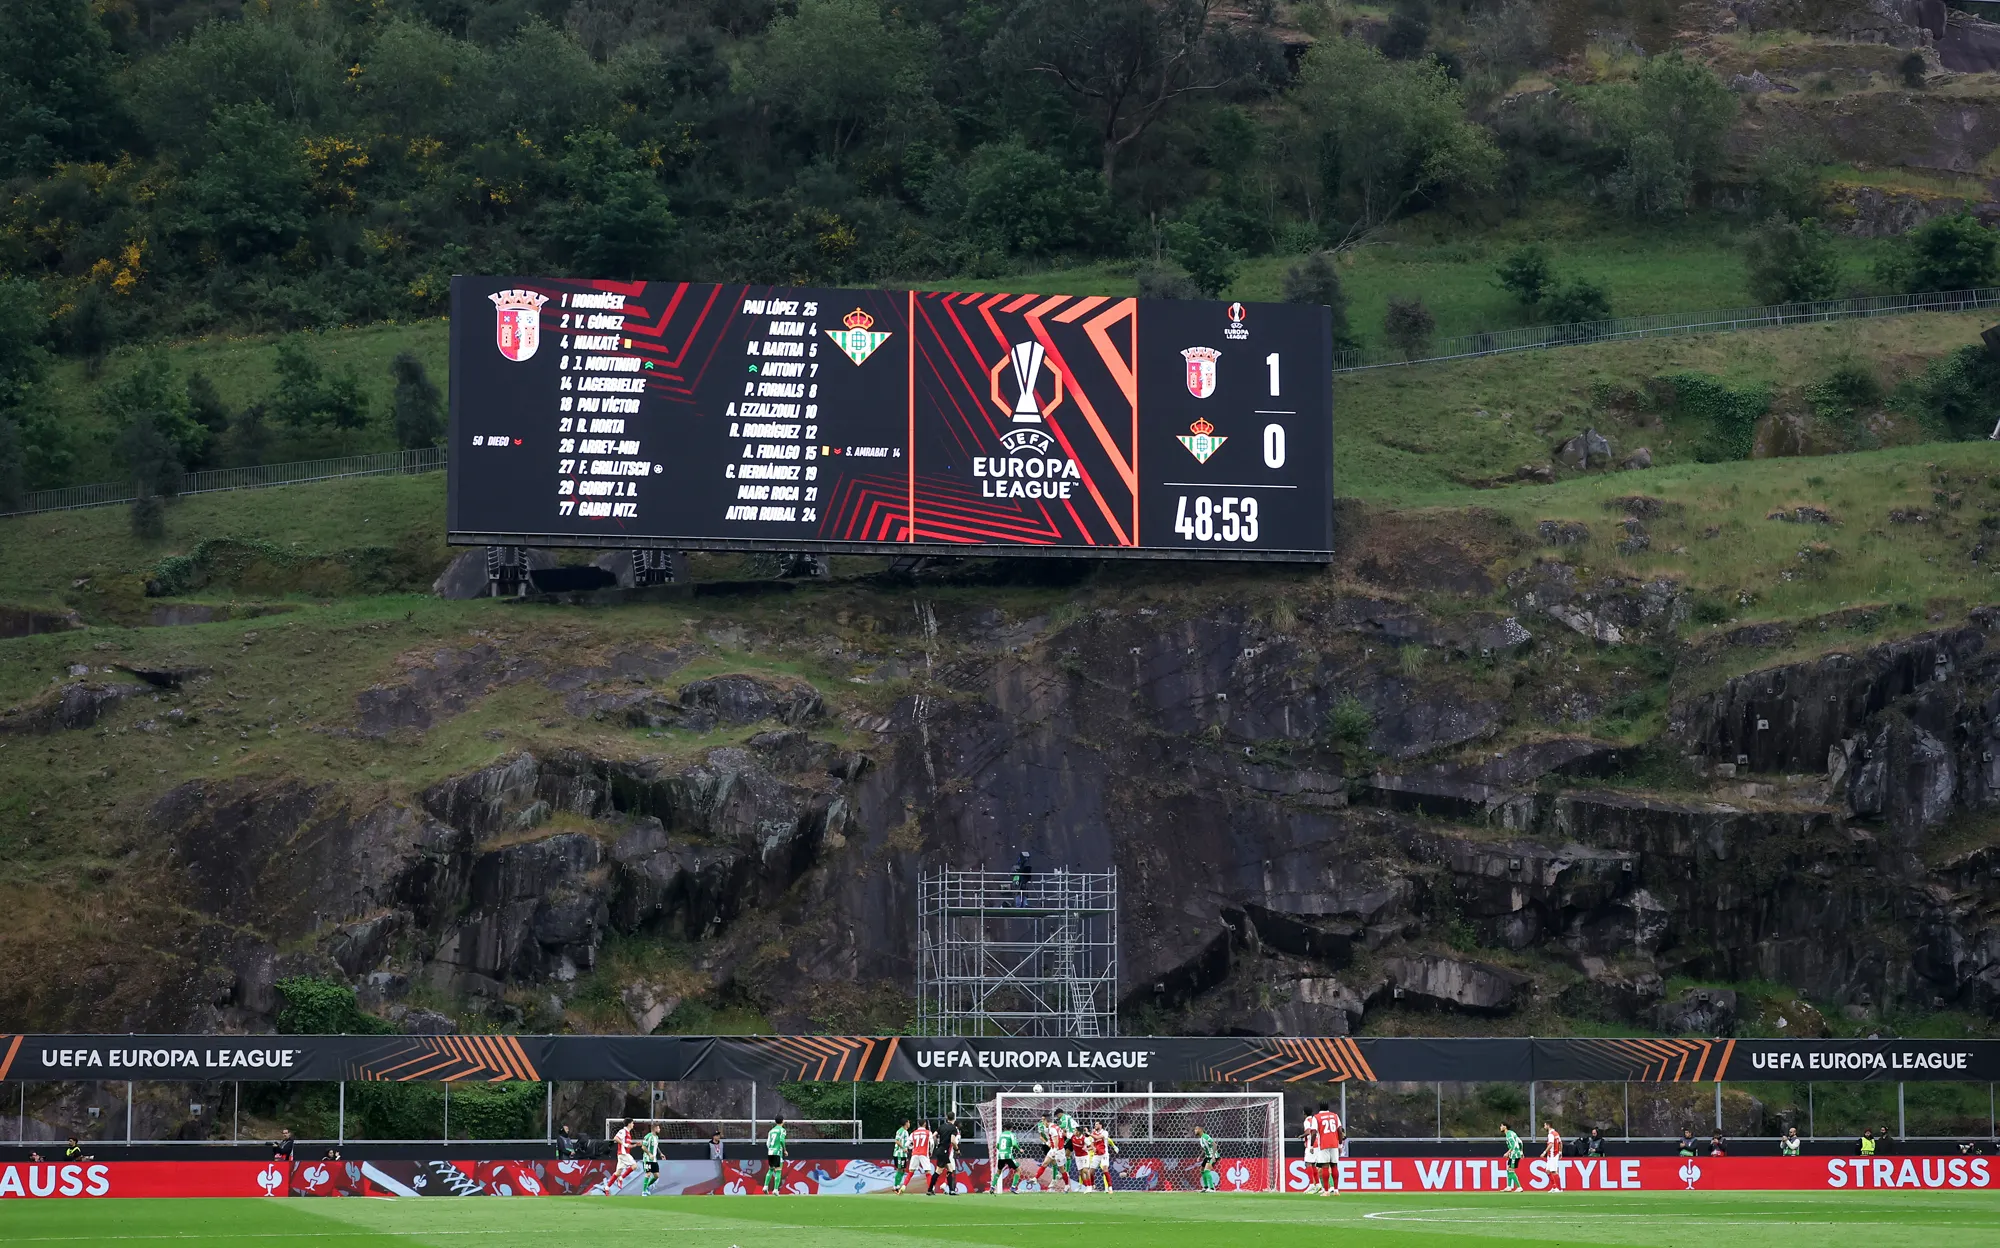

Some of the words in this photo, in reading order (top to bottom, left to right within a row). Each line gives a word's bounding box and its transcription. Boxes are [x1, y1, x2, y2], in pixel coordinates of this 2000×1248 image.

[560, 293, 568, 307] 1
[571, 292, 626, 310] HORNÍČEK
[743, 300, 765, 314] PAU
[766, 298, 799, 316] LÓPEZ
[803, 302, 818, 316] 25
[560, 314, 568, 328] 2
[574, 315, 585, 329] V.
[587, 312, 625, 330] GÓMEZ
[769, 321, 804, 336] NATAN
[809, 323, 817, 336] 4
[560, 335, 568, 350] 4
[574, 334, 620, 350] NIAKATÉ
[747, 341, 760, 356] M.
[762, 342, 804, 357] BARTRA
[809, 343, 818, 357] 5
[560, 356, 568, 370] 8
[585, 357, 641, 372] MOUTINHO
[761, 362, 805, 377] ANTONY
[810, 364, 818, 378] 7
[1266, 353, 1279, 396] 1
[560, 377, 572, 390] 14
[578, 377, 646, 393] LAGERBIELKE
[745, 382, 754, 396] P.
[757, 383, 804, 398] FORNALS
[809, 384, 818, 398] 8
[560, 397, 572, 411] 18
[577, 398, 600, 412] PAU
[601, 395, 640, 413] VÍCTOR
[726, 402, 737, 416] A.
[740, 403, 800, 418] EZZALZOULI
[805, 405, 818, 419] 10
[559, 418, 573, 432] 21
[576, 418, 587, 433] R.
[590, 419, 624, 434] HORTA
[730, 423, 739, 437] R.
[743, 422, 801, 439] RODRÍGUEZ
[805, 425, 818, 439] 12
[473, 436, 483, 446] 50
[488, 436, 509, 446] DIEGO
[559, 438, 575, 453] 26
[579, 439, 640, 455] ARREY-MBI
[1003, 431, 1050, 454] UEFA
[1263, 424, 1286, 468] 0
[743, 444, 754, 458] A.
[756, 445, 800, 460] FIDALGO
[805, 446, 817, 460] 15
[846, 446, 853, 456] S.
[854, 447, 888, 458] AMRABAT
[892, 448, 900, 458] 14
[559, 460, 575, 474] 27
[579, 460, 588, 474] F.
[590, 460, 651, 476] GRILLITSCH
[738, 462, 801, 480] HERNÁNDEZ
[805, 466, 817, 480] 19
[973, 457, 1080, 480] EUROPA
[558, 480, 574, 495] 29
[579, 481, 615, 496] GORBY
[627, 482, 638, 497] B.
[738, 485, 769, 500] MARC
[770, 486, 800, 501] ROCA
[804, 487, 818, 501] 21
[559, 501, 575, 515] 77
[579, 502, 612, 517] GABRI
[613, 502, 638, 518] MTZ.
[725, 506, 757, 520] AITOR
[759, 506, 796, 522] RUIBAL
[802, 508, 816, 522] 24
[1174, 496, 1259, 542] 48:53
[42, 1050, 102, 1067] UEFA
[109, 1050, 199, 1067] EUROPA
[917, 1051, 974, 1068] UEFA
[979, 1051, 1061, 1068] EUROPA
[1752, 1053, 1804, 1069] UEFA
[1810, 1053, 1886, 1069] EUROPA
[1322, 1120, 1336, 1134] 26
[914, 1134, 926, 1147] 77
[1001, 1138, 1008, 1150] 8
[1289, 1160, 1403, 1190] SEEL
[1414, 1160, 1514, 1190] WITH
[1529, 1160, 1641, 1190] STYLE
[1827, 1158, 1990, 1188] STRAUSS
